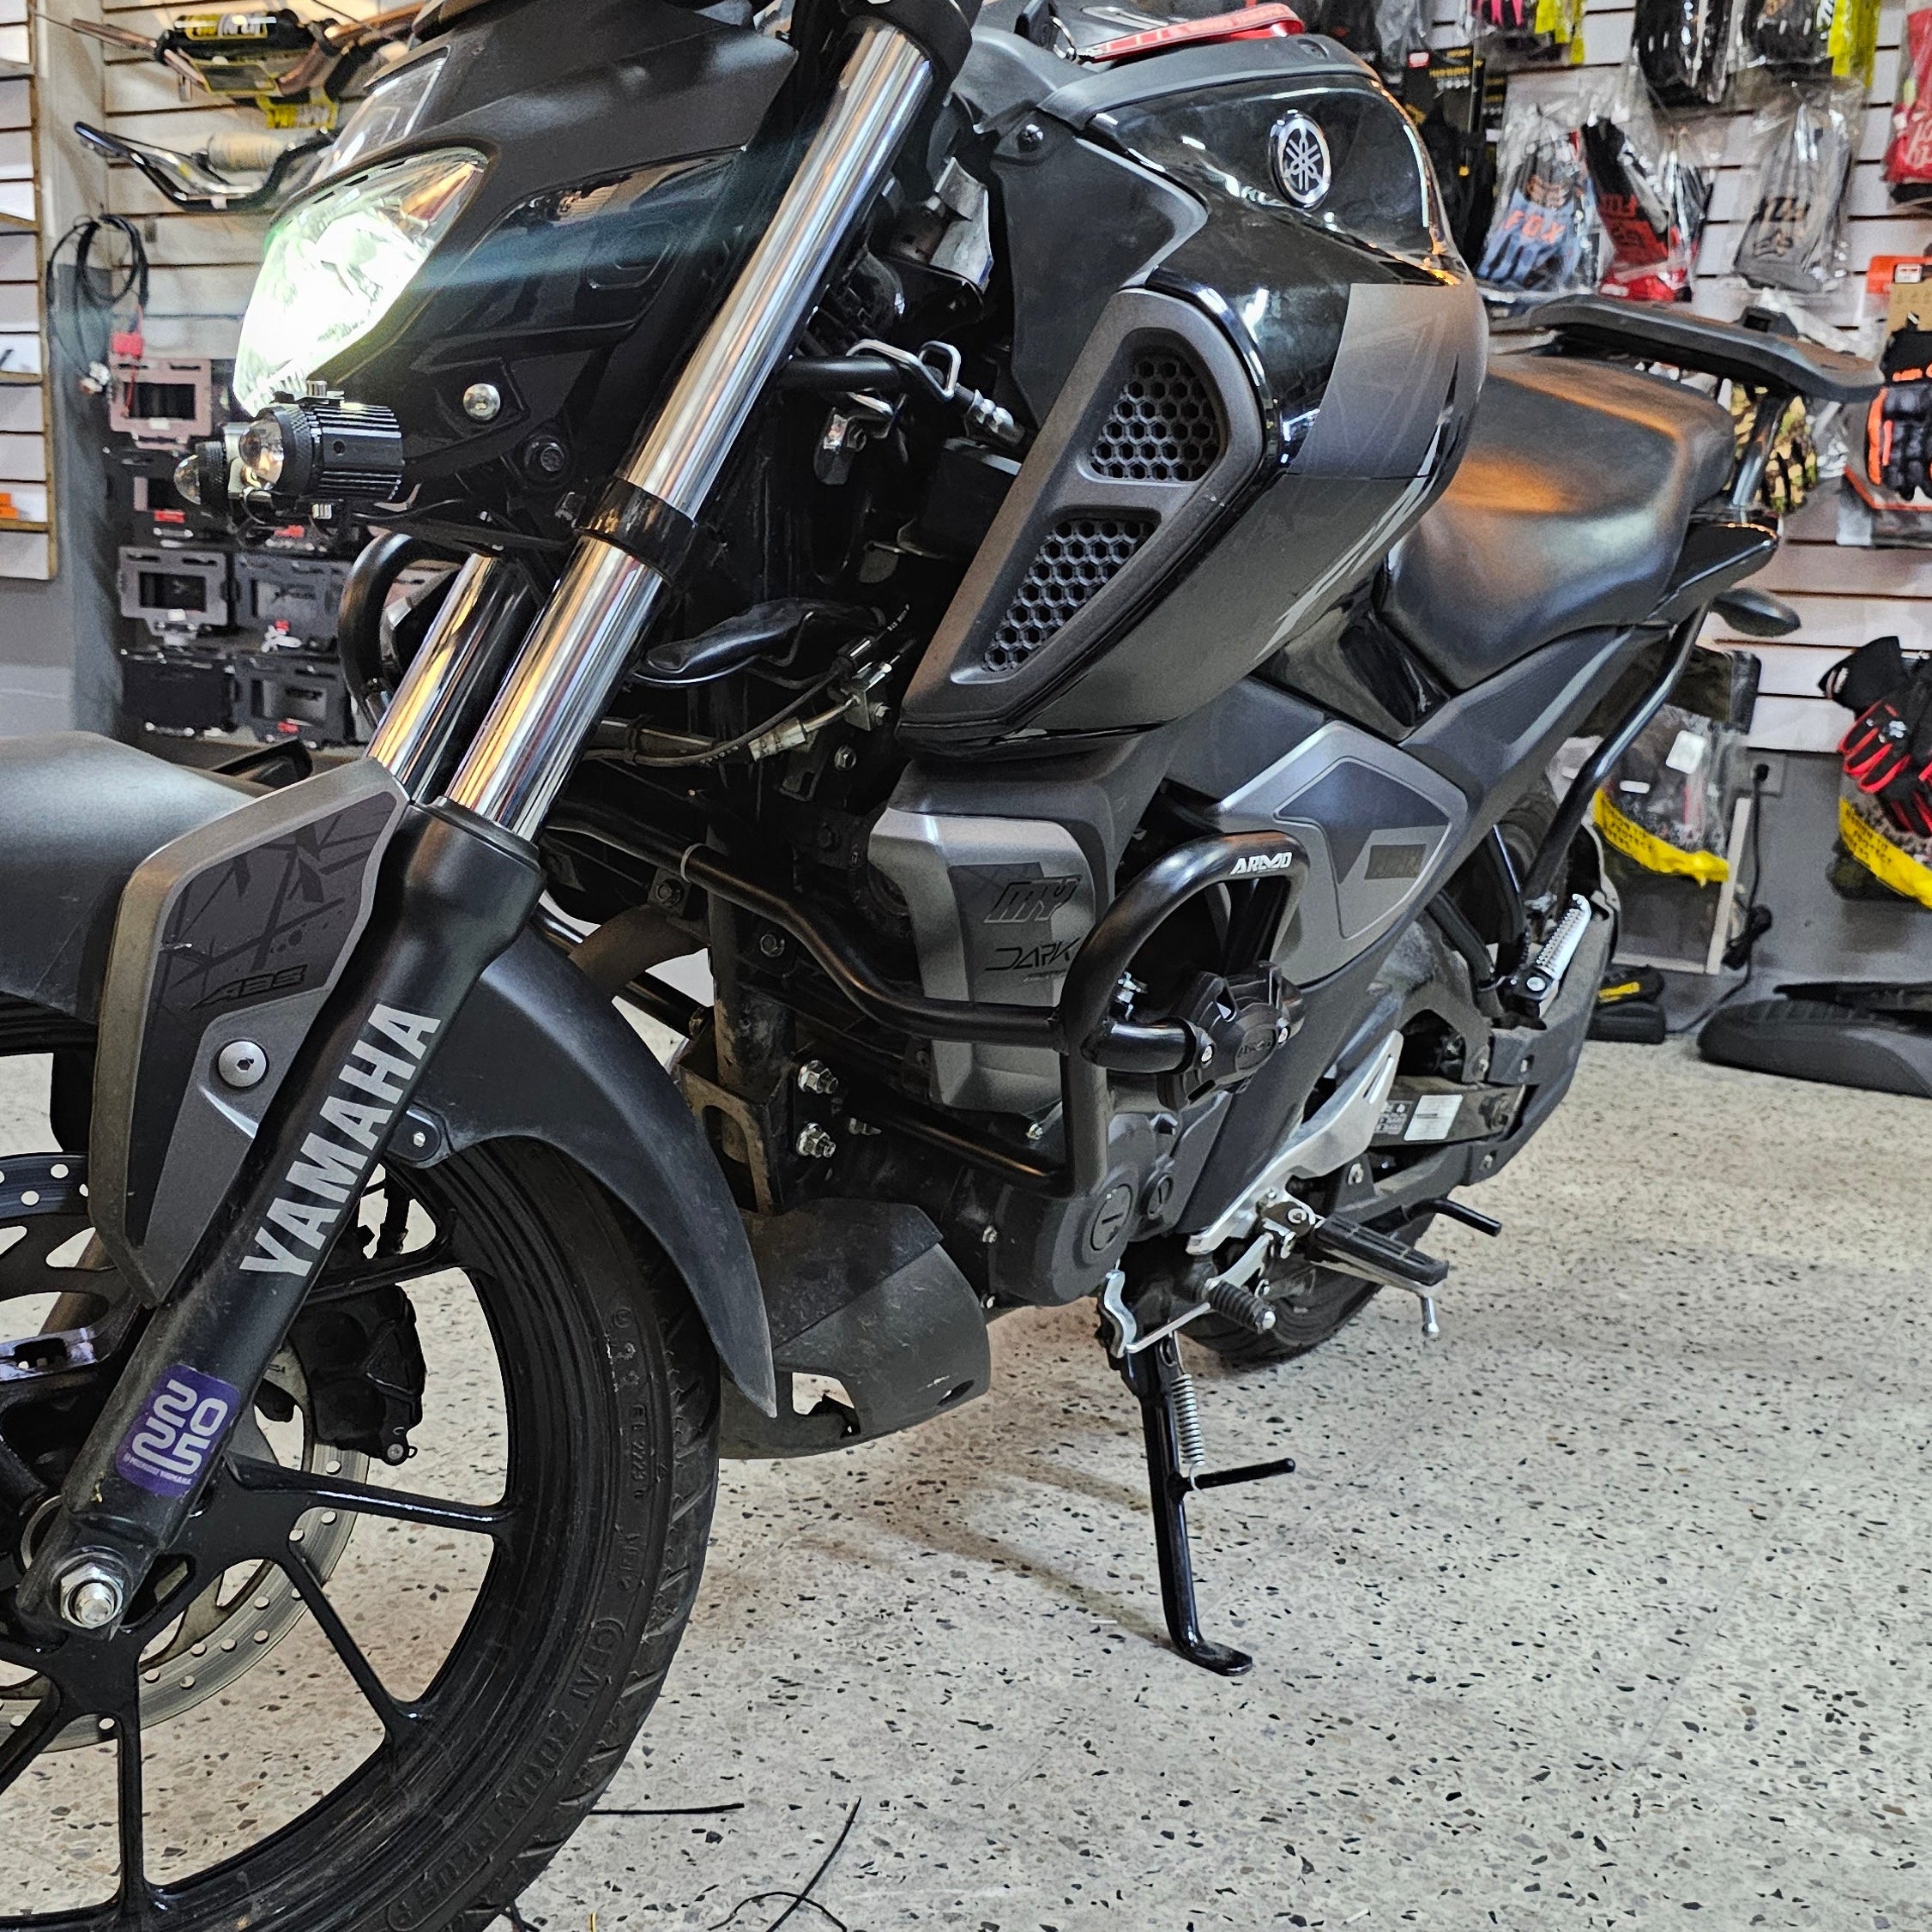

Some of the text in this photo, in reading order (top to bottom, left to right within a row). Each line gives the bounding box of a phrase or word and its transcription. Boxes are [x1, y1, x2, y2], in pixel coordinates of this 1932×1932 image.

[1504, 210, 1565, 244] FOX
[985, 937, 1082, 971] DARK
[239, 1004, 441, 1277] YAMAHA
